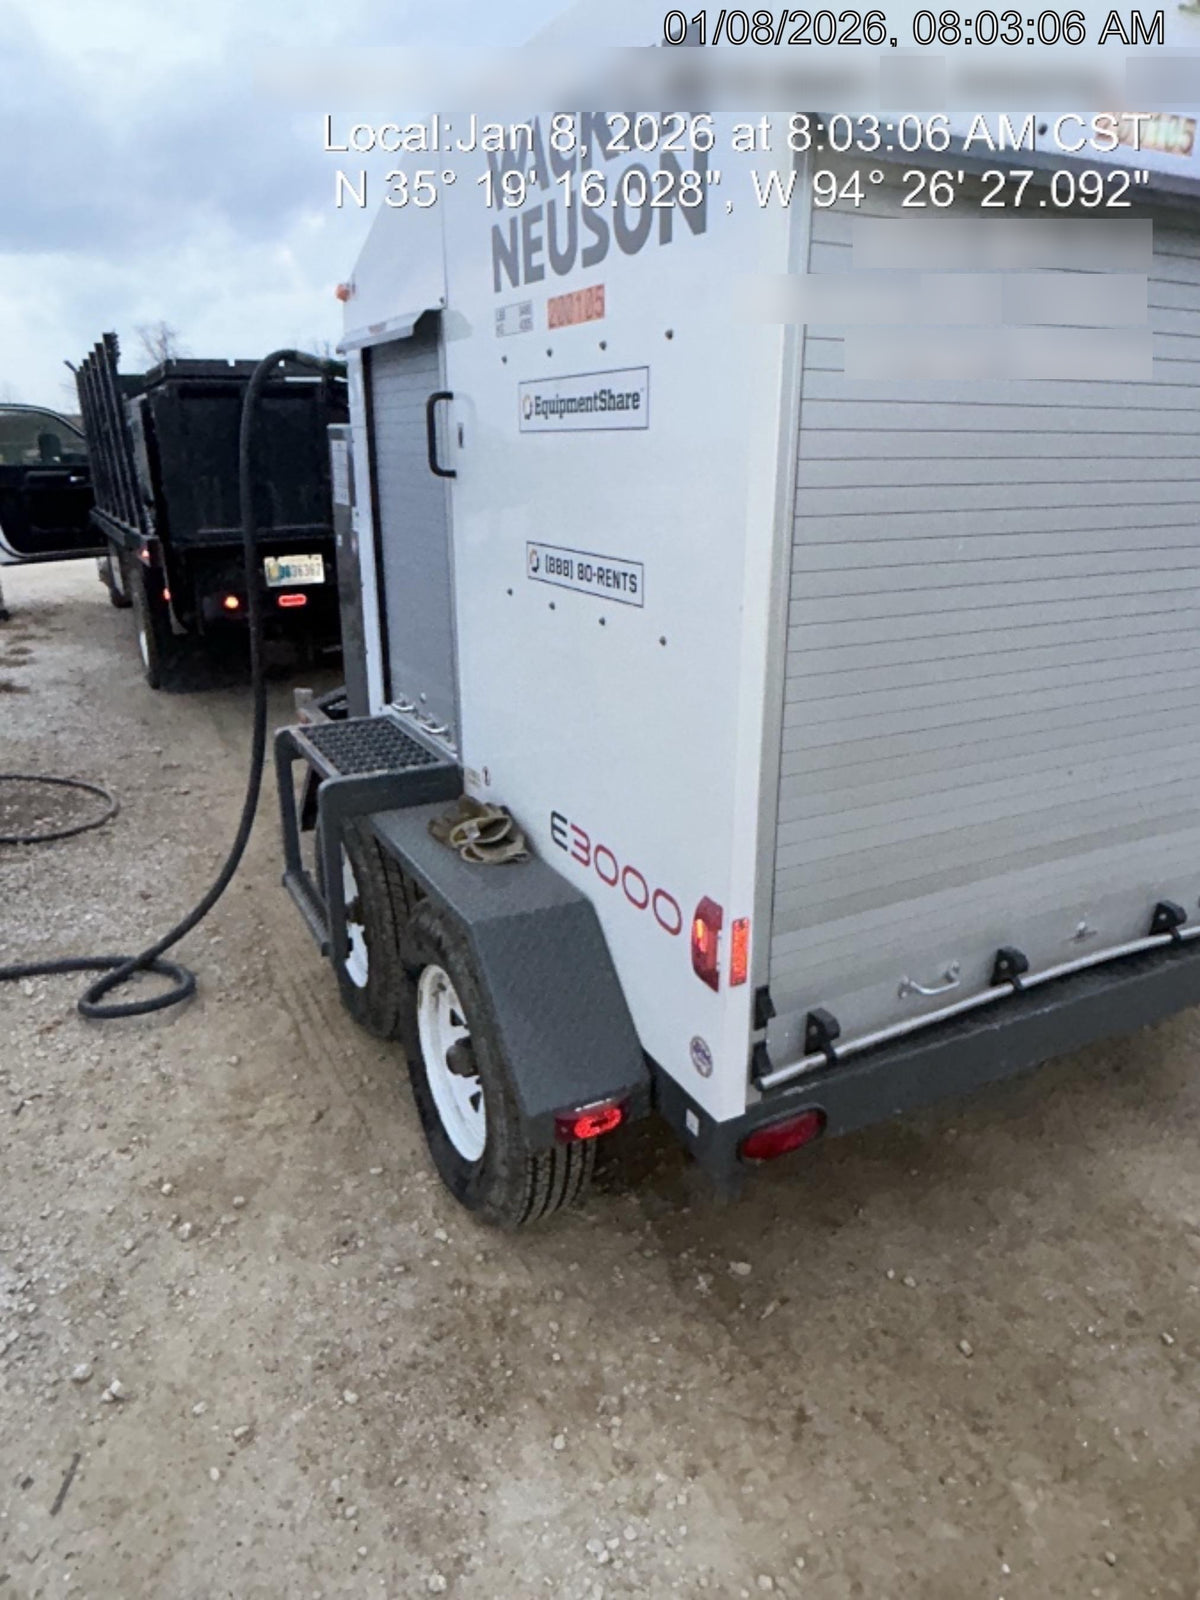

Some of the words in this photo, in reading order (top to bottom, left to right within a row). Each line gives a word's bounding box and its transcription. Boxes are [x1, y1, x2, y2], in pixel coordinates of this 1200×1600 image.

[491, 151, 710, 293] NEUSON
[534, 388, 641, 420] EquipmentShare
[577, 562, 638, 594] 80-RENTS
[550, 810, 683, 936] E3000
